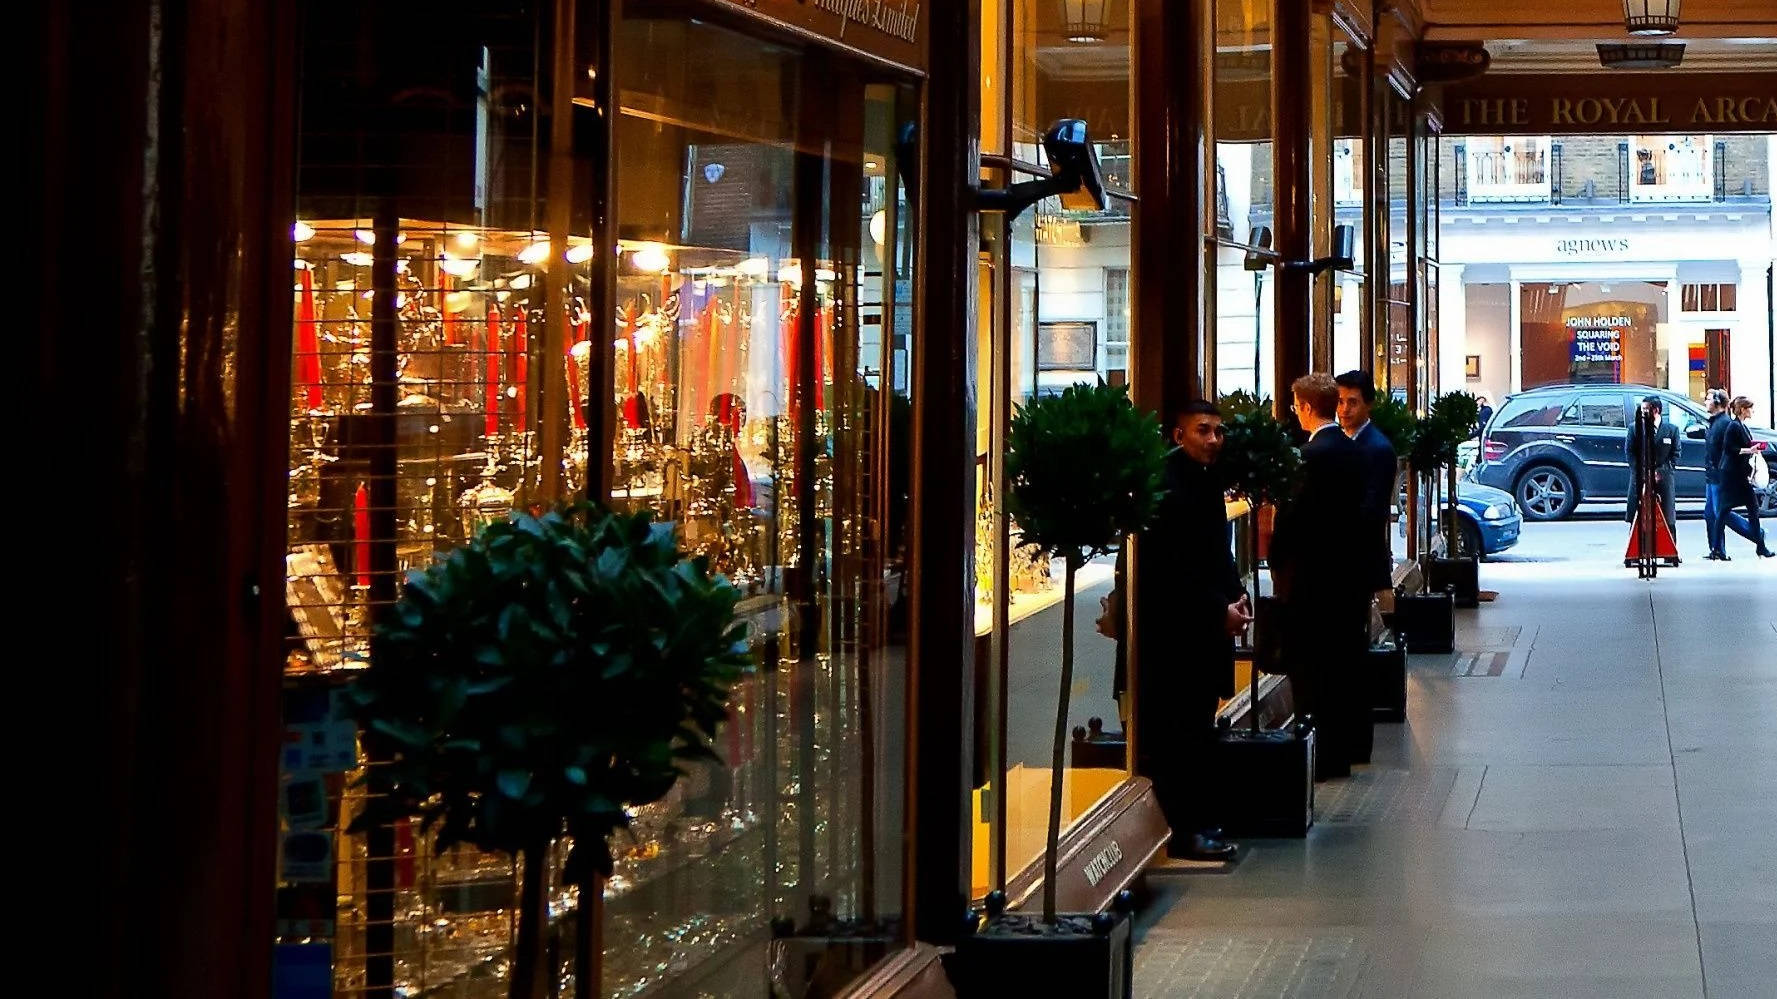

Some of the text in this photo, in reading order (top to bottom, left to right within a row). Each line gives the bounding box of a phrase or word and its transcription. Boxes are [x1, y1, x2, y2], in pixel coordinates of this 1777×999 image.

[1461, 97, 1529, 125] THE
[1551, 96, 1670, 125] ROYAL
[1566, 316, 1632, 328] JOHN HOLDEN
[1576, 330, 1620, 340] SQUARING
[1577, 342, 1620, 352] THE VOID
